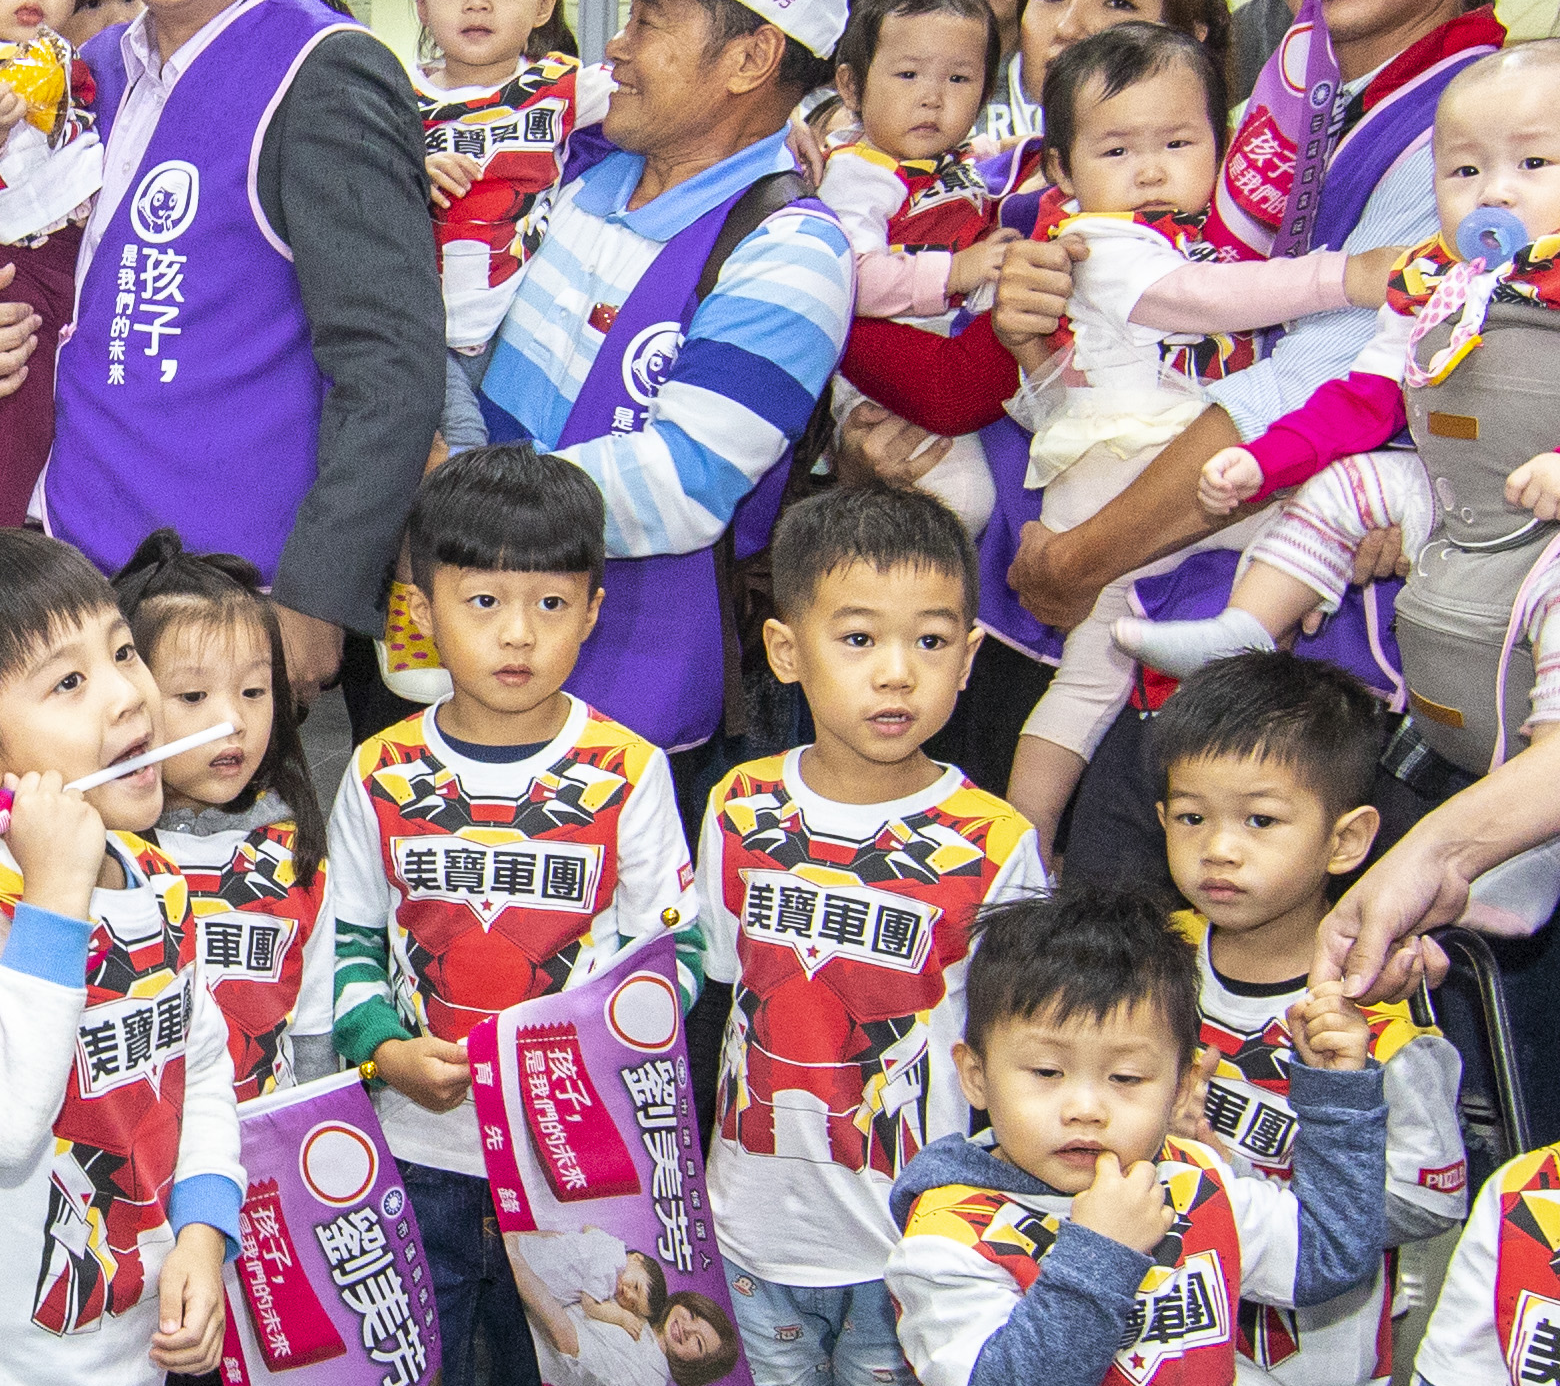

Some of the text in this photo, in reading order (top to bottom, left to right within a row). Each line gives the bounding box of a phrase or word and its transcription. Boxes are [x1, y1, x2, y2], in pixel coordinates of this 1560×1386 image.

[107, 243, 139, 385] 是我們的未來
[133, 246, 187, 383] 孩子，
[403, 846, 589, 902] 美寶軍團
[747, 880, 927, 962] 美寶軍團
[525, 1050, 587, 1192] 是我們的未來
[547, 1046, 584, 1127] 孩子，
[623, 1058, 694, 1275] 劉美芳
